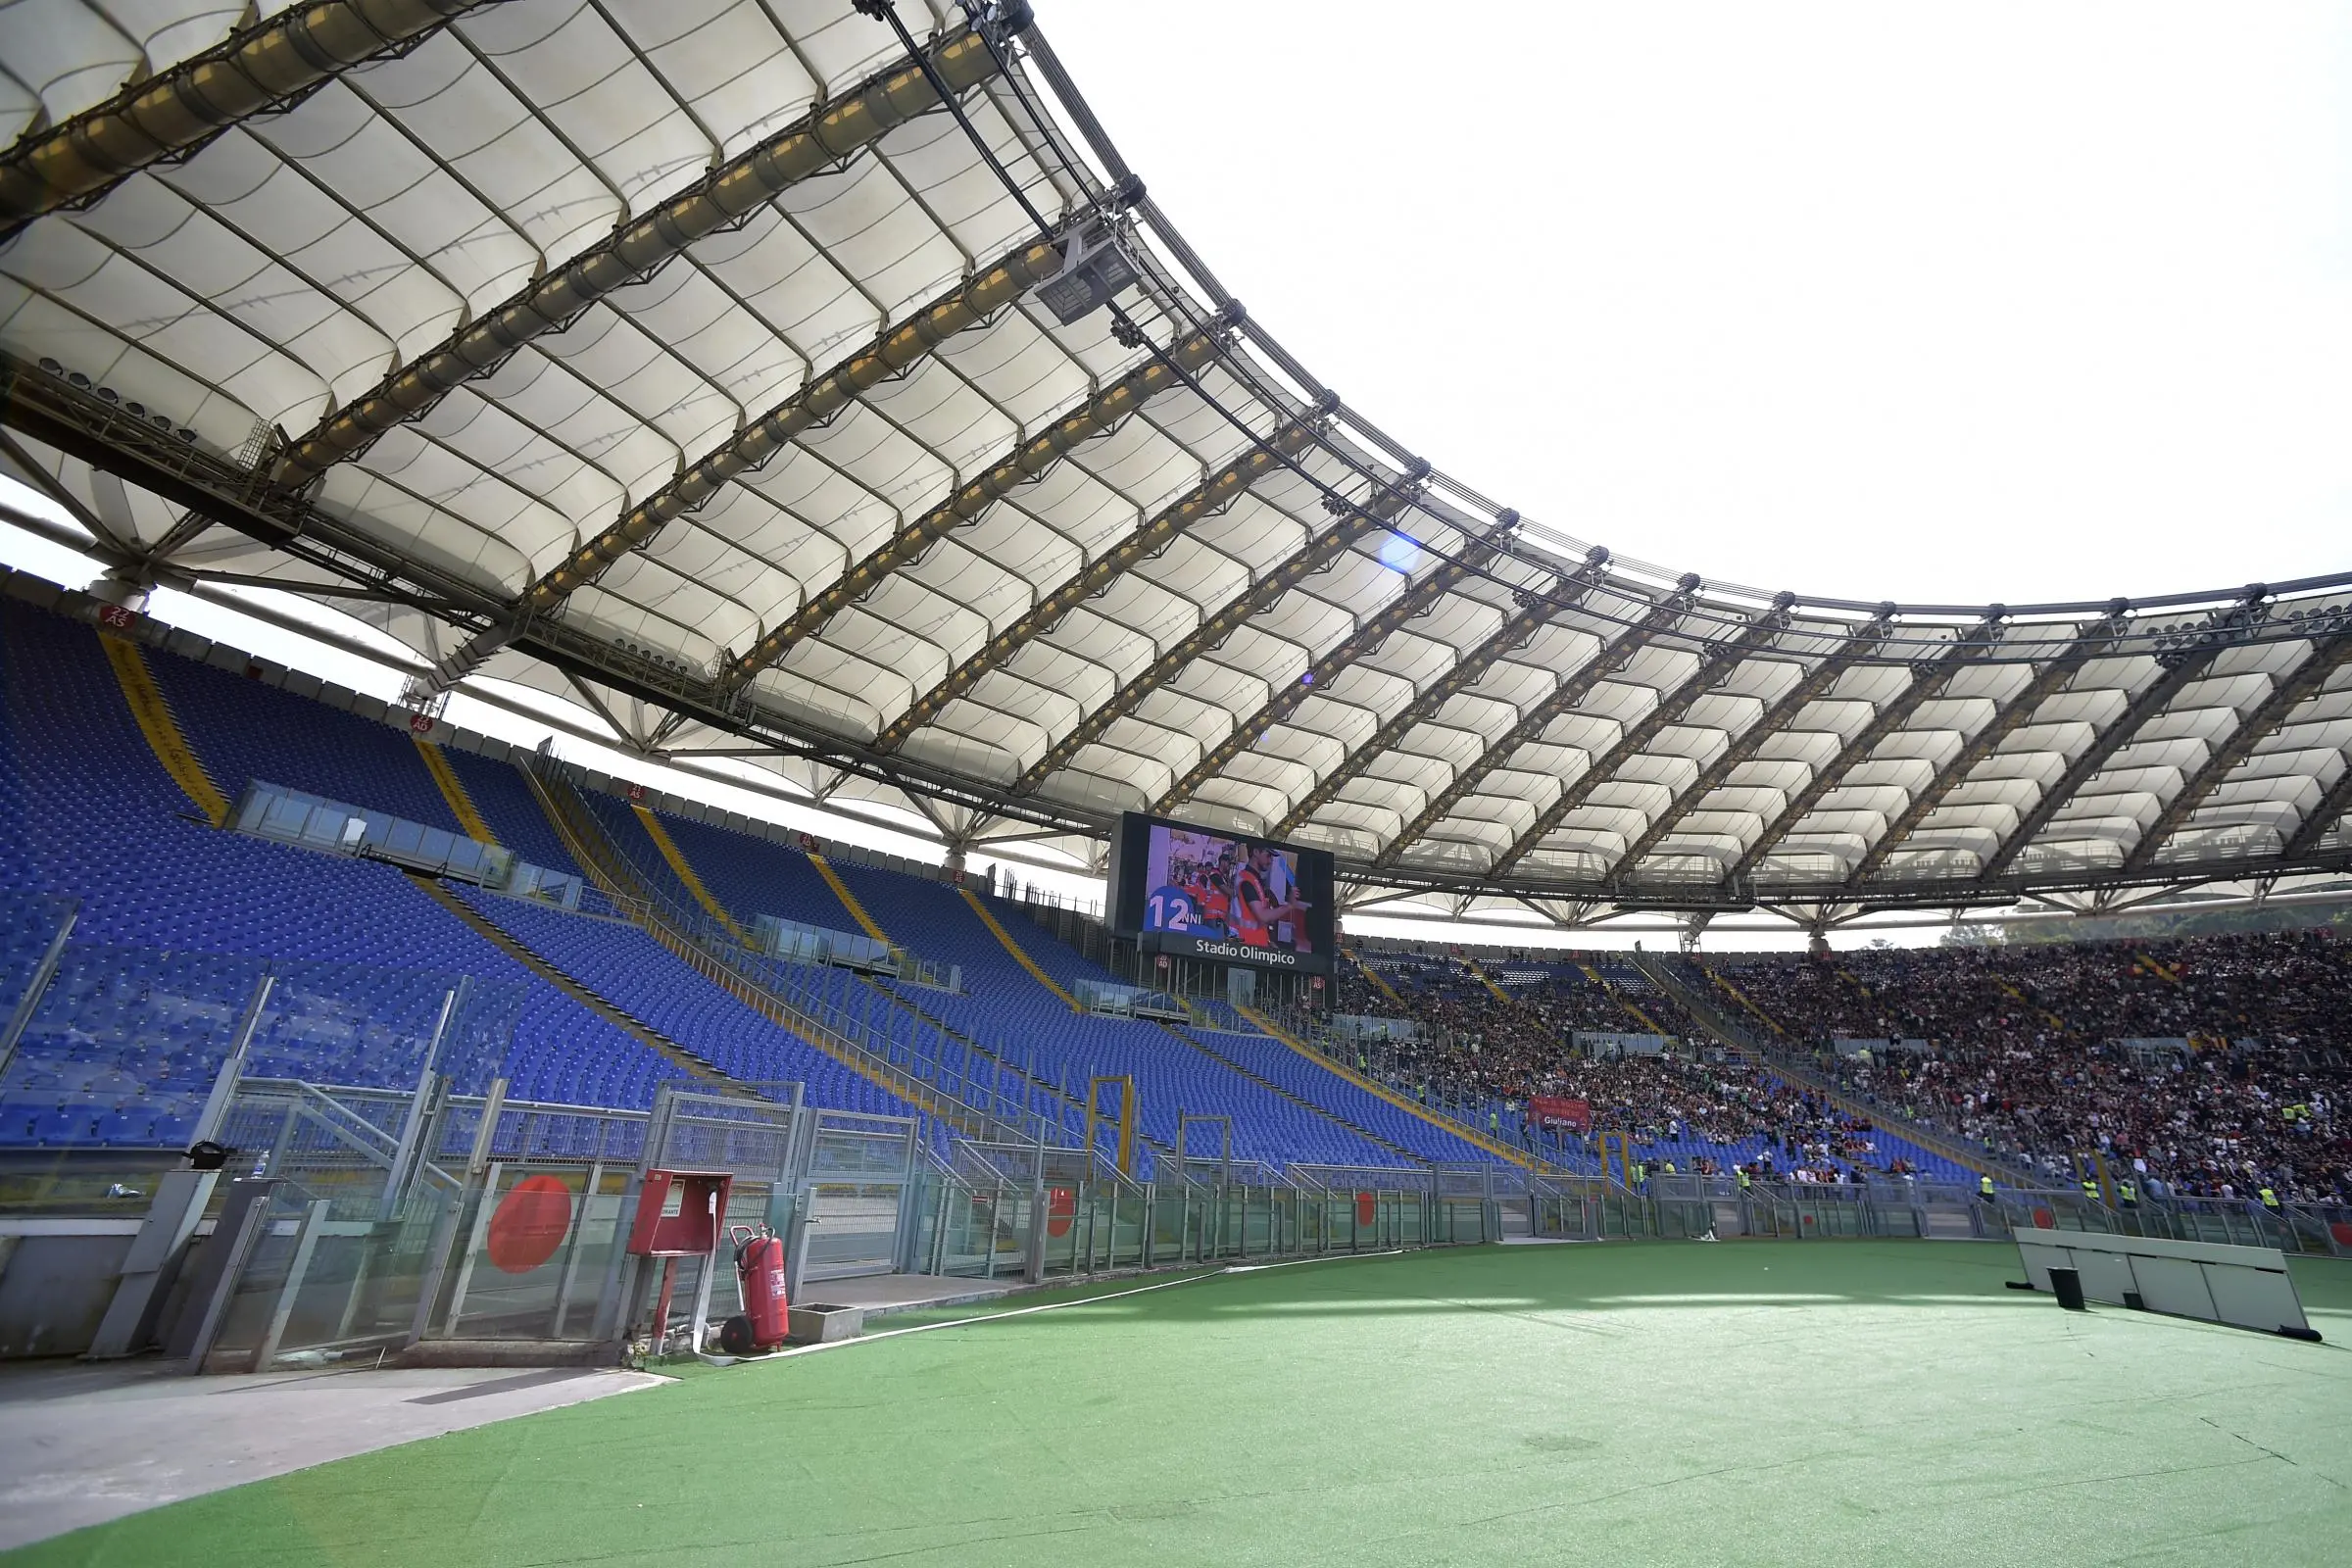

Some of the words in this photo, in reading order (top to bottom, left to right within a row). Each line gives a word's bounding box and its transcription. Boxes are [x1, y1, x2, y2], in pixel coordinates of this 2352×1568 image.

[111, 607, 130, 619] 22
[105, 615, 126, 627] AS
[412, 721, 428, 731] AD
[629, 790, 641, 799] AS
[1150, 895, 1188, 931] 12
[1182, 912, 1201, 925] NNI
[1196, 939, 1238, 957] Stadio
[1240, 945, 1296, 965] Olimpico
[1544, 1115, 1577, 1127] Giuliano
